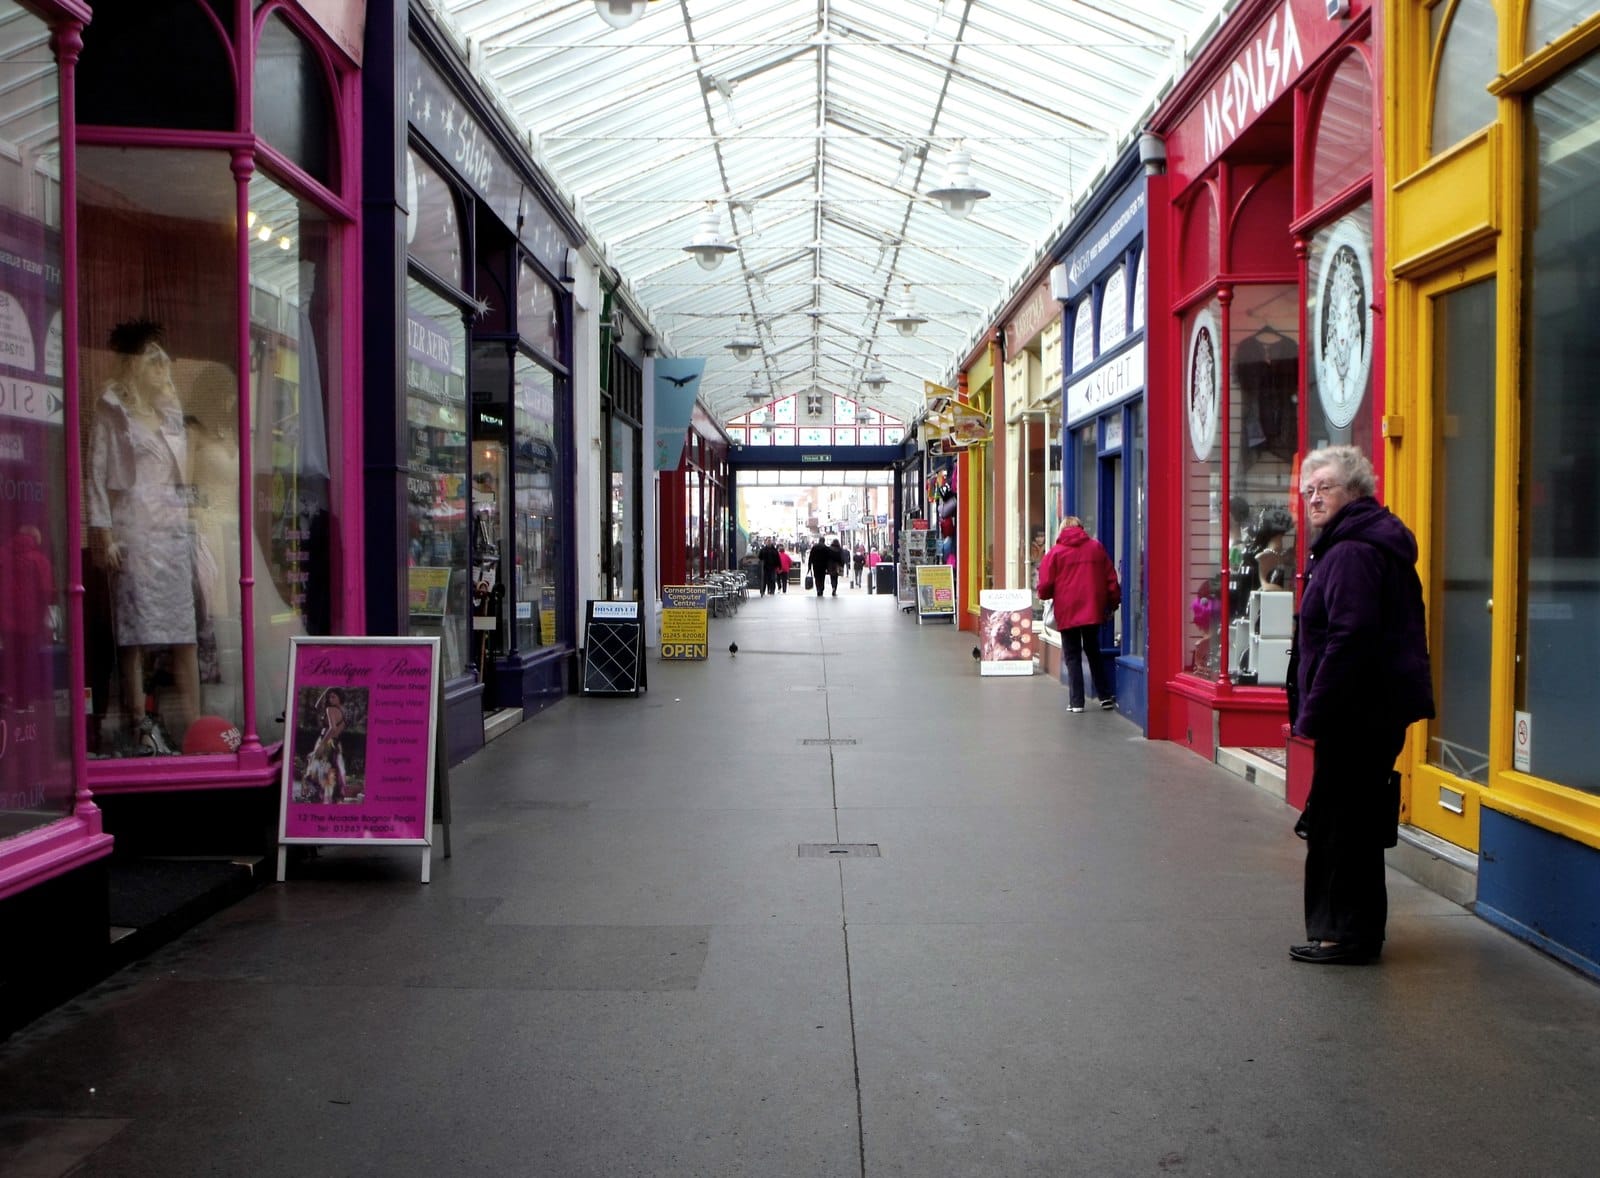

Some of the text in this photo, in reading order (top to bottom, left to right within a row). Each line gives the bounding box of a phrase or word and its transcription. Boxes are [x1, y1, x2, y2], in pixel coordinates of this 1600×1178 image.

[1203, 2, 1304, 163] MEDUSA
[455, 114, 493, 193] Silver
[1096, 357, 1131, 403] SIGHT
[667, 593, 701, 601] Computer
[673, 599, 696, 607] Centre
[661, 644, 706, 658] OPEN
[306, 656, 428, 682] Boutique Roma
[309, 813, 325, 821] The
[327, 813, 359, 822] Arcade
